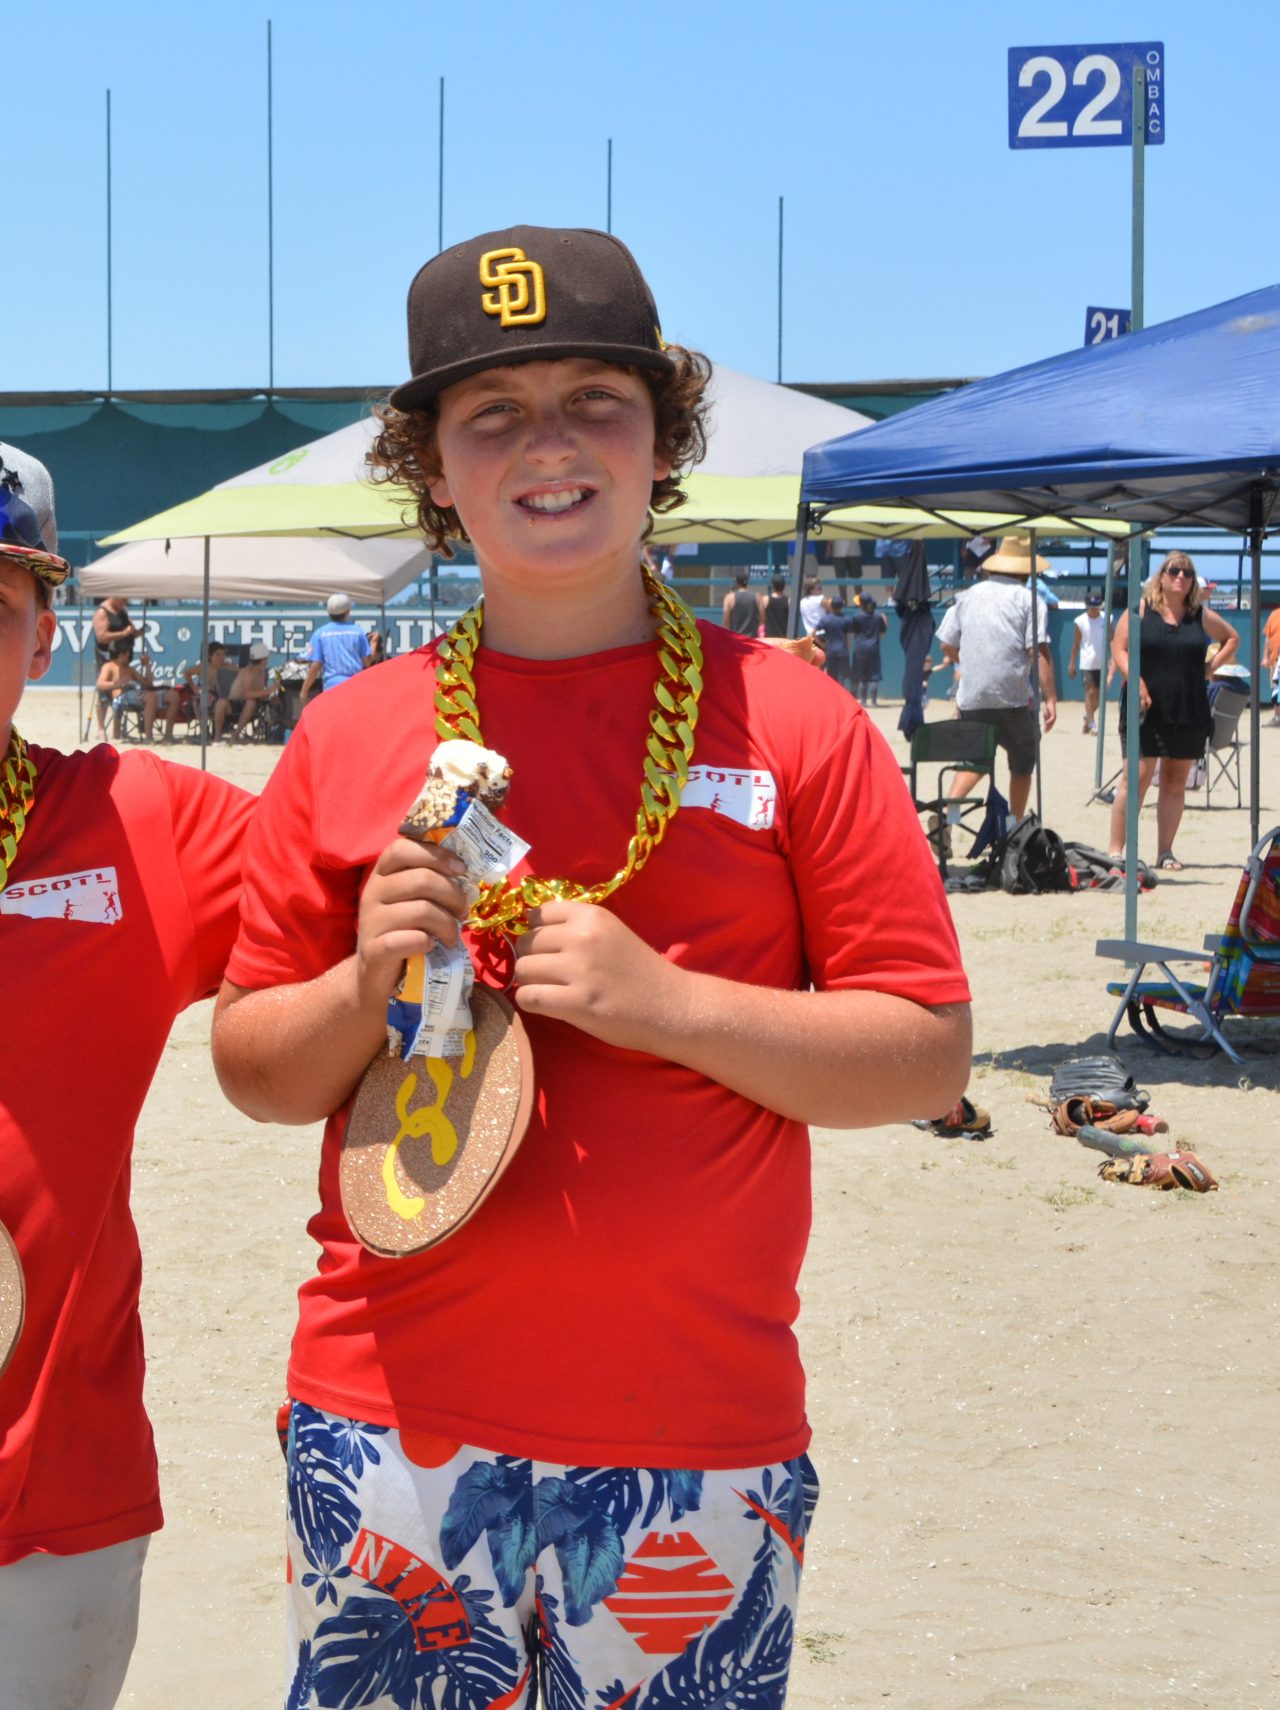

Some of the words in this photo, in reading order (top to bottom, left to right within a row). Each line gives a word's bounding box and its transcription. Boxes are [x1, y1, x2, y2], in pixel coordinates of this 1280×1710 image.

[1018, 54, 1123, 138] 22
[1146, 50, 1161, 134] OMBAC
[479, 247, 548, 327] SD
[1090, 311, 1120, 345] 21
[51, 619, 165, 653] VR
[207, 619, 314, 653] THE
[351, 1531, 469, 1649] NIKE
